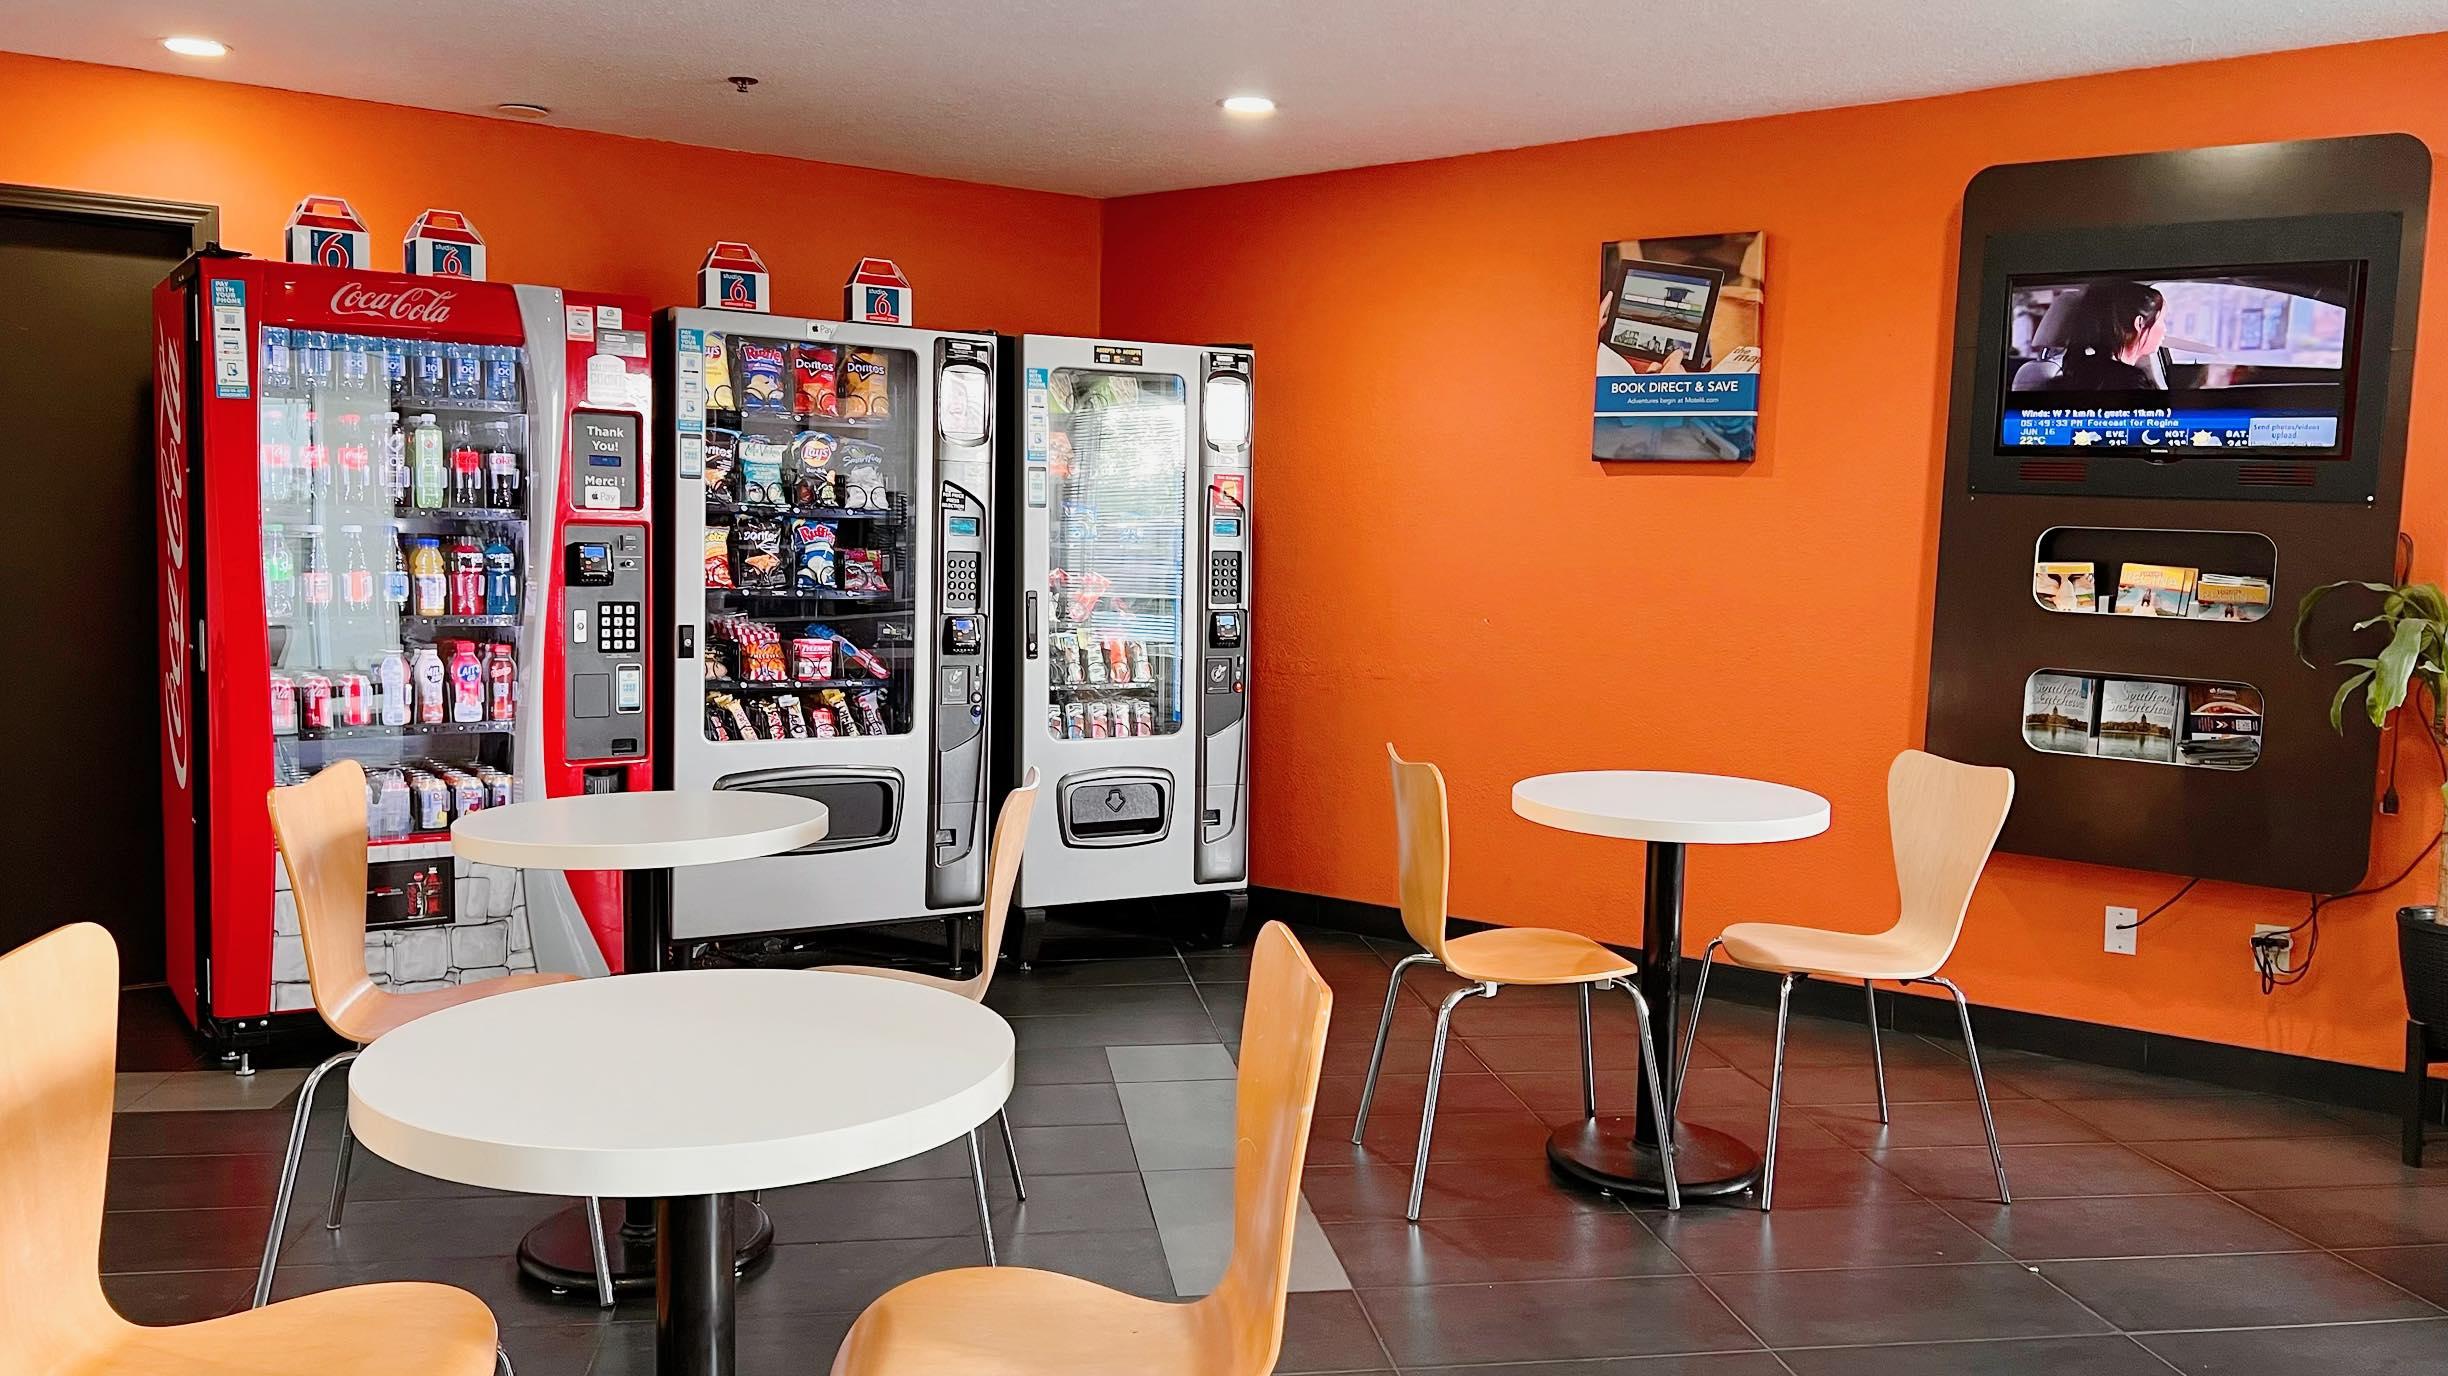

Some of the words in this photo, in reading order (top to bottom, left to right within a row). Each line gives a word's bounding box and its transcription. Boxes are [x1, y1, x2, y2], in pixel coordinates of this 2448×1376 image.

[443, 249, 463, 276] 6
[729, 279, 748, 302] 6
[330, 282, 459, 323] Coca-Cola
[874, 293, 891, 316] 6
[820, 325, 834, 335] Pay
[795, 359, 834, 371] Doritos
[847, 362, 885, 375] Doritos
[1611, 382, 1645, 394] BOOK
[1648, 381, 1692, 393] DIRECT
[1695, 381, 1705, 392] &
[1707, 380, 1738, 392] SAVE
[1660, 397, 1676, 405] begin
[2021, 409, 2050, 418] Winds:
[2052, 410, 2062, 418] W
[2073, 409, 2096, 418] km/h
[2088, 419, 2127, 427] Forecast
[2130, 419, 2144, 427] for
[2147, 419, 2179, 428] Regina
[587, 425, 624, 438] Thank
[2020, 428, 2038, 436] JUN
[592, 440, 619, 452] You!
[584, 475, 618, 487] Merci
[600, 492, 615, 503] Pay
[158, 313, 187, 790] Coca-Cola
[802, 644, 831, 653] TYLENOL
